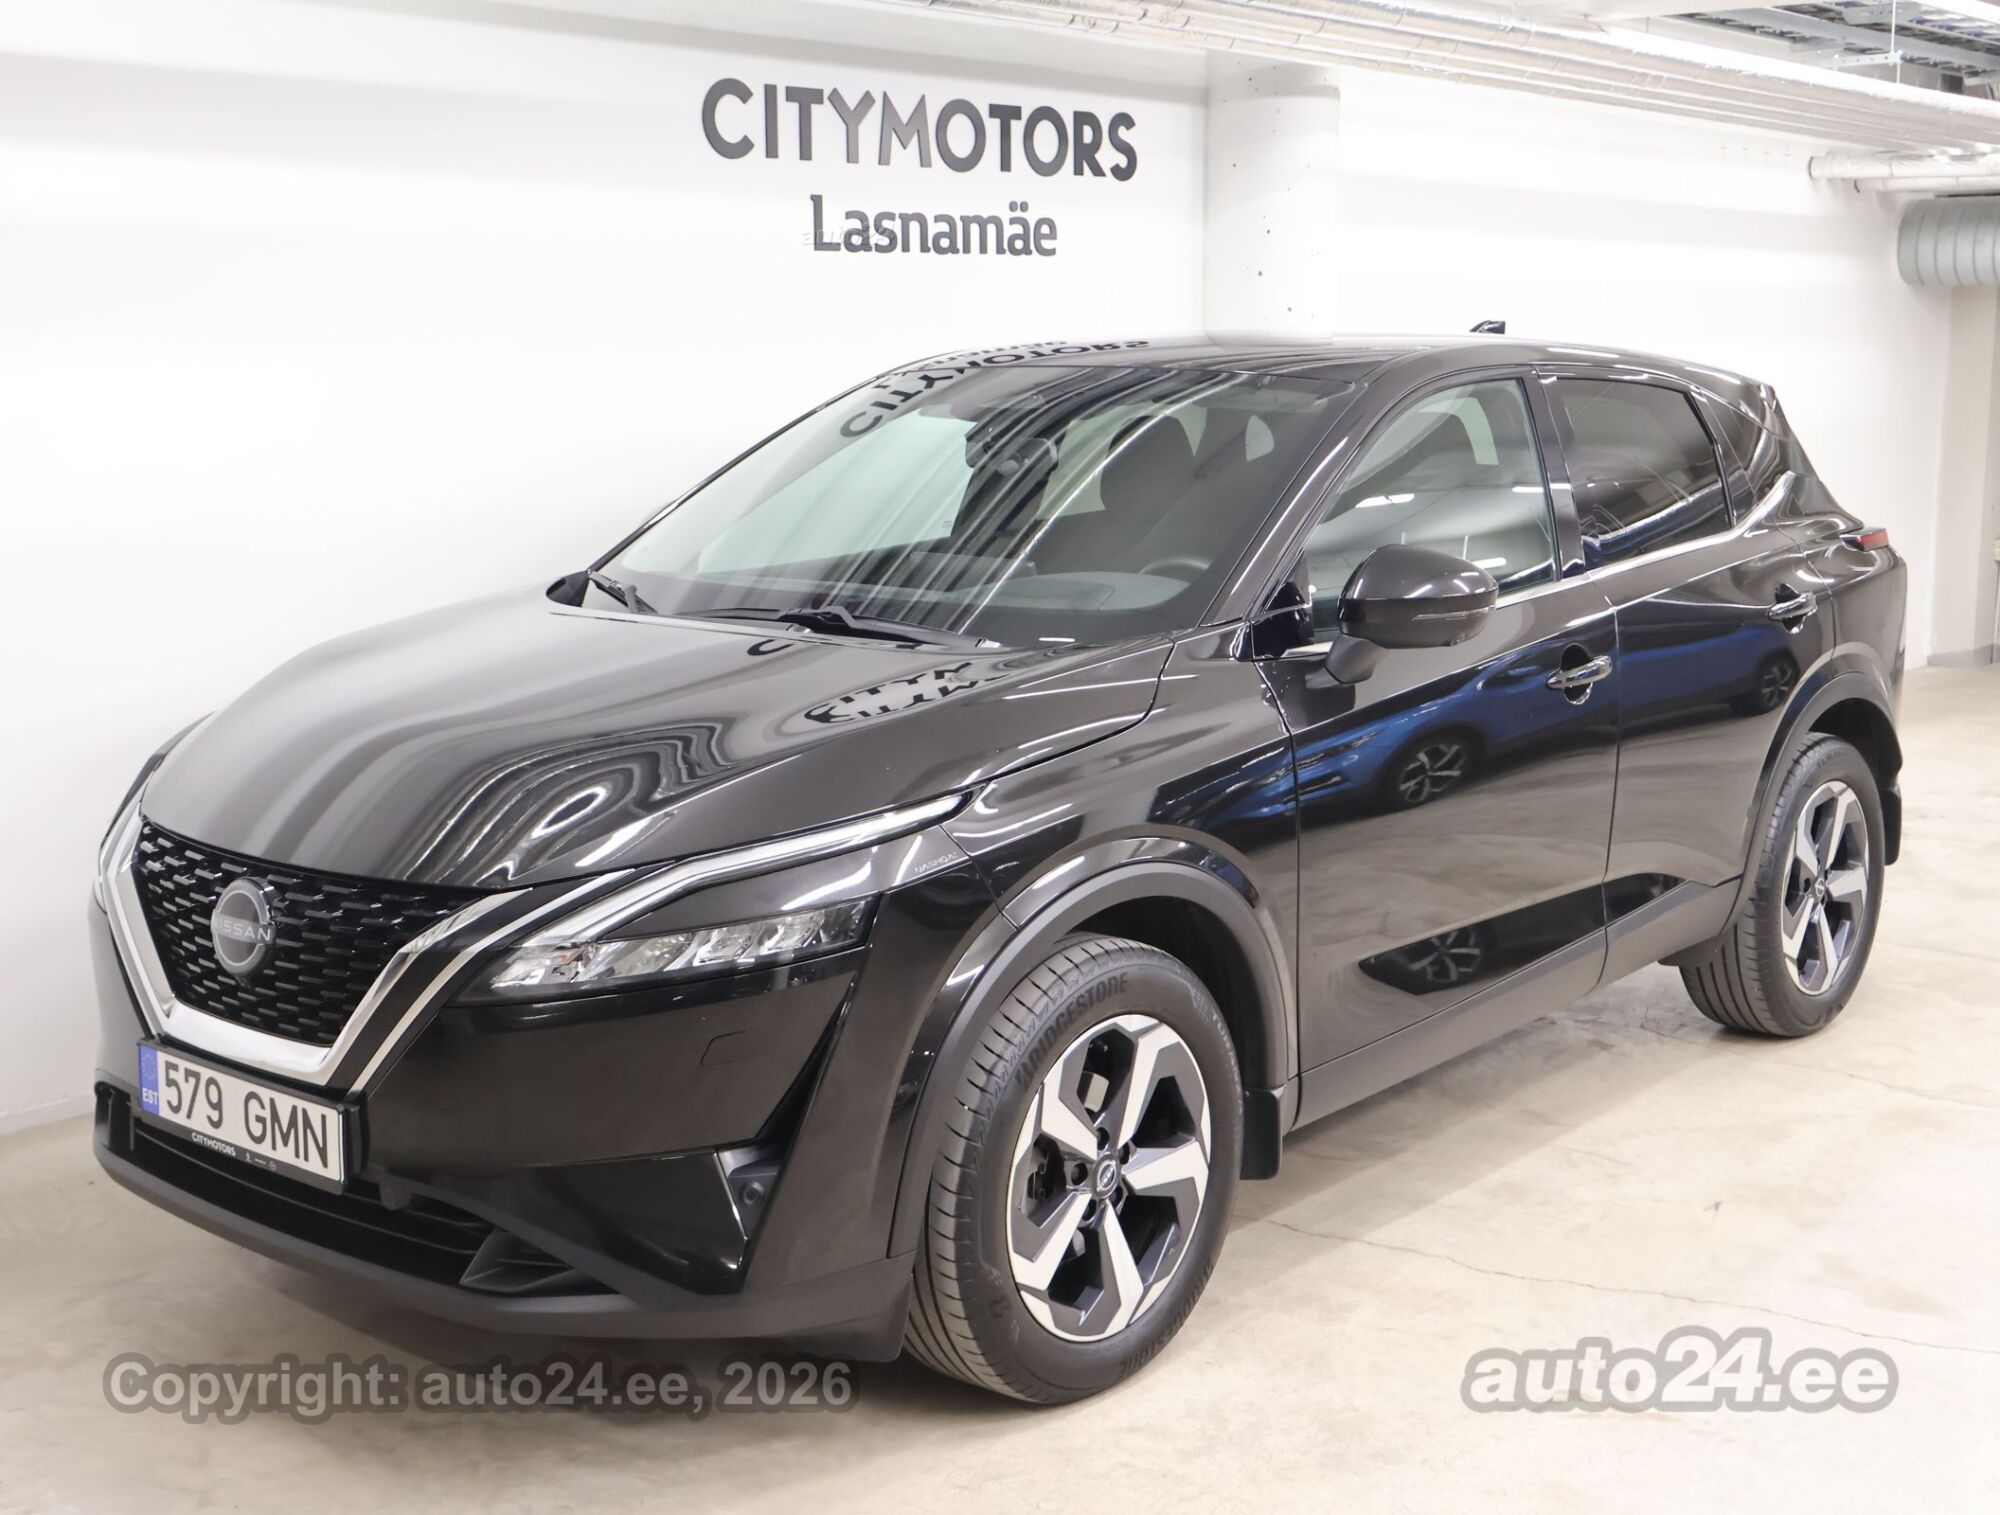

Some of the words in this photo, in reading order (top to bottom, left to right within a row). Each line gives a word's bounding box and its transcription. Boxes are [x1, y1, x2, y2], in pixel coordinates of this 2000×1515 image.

[702, 78, 1137, 182] CITYMOTORS
[810, 194, 1057, 256] Lasnamäe
[142, 1087, 159, 1106] EST
[164, 1060, 223, 1130] 579
[243, 1091, 328, 1169] GMN
[191, 1131, 237, 1157] CITYMOTORS
